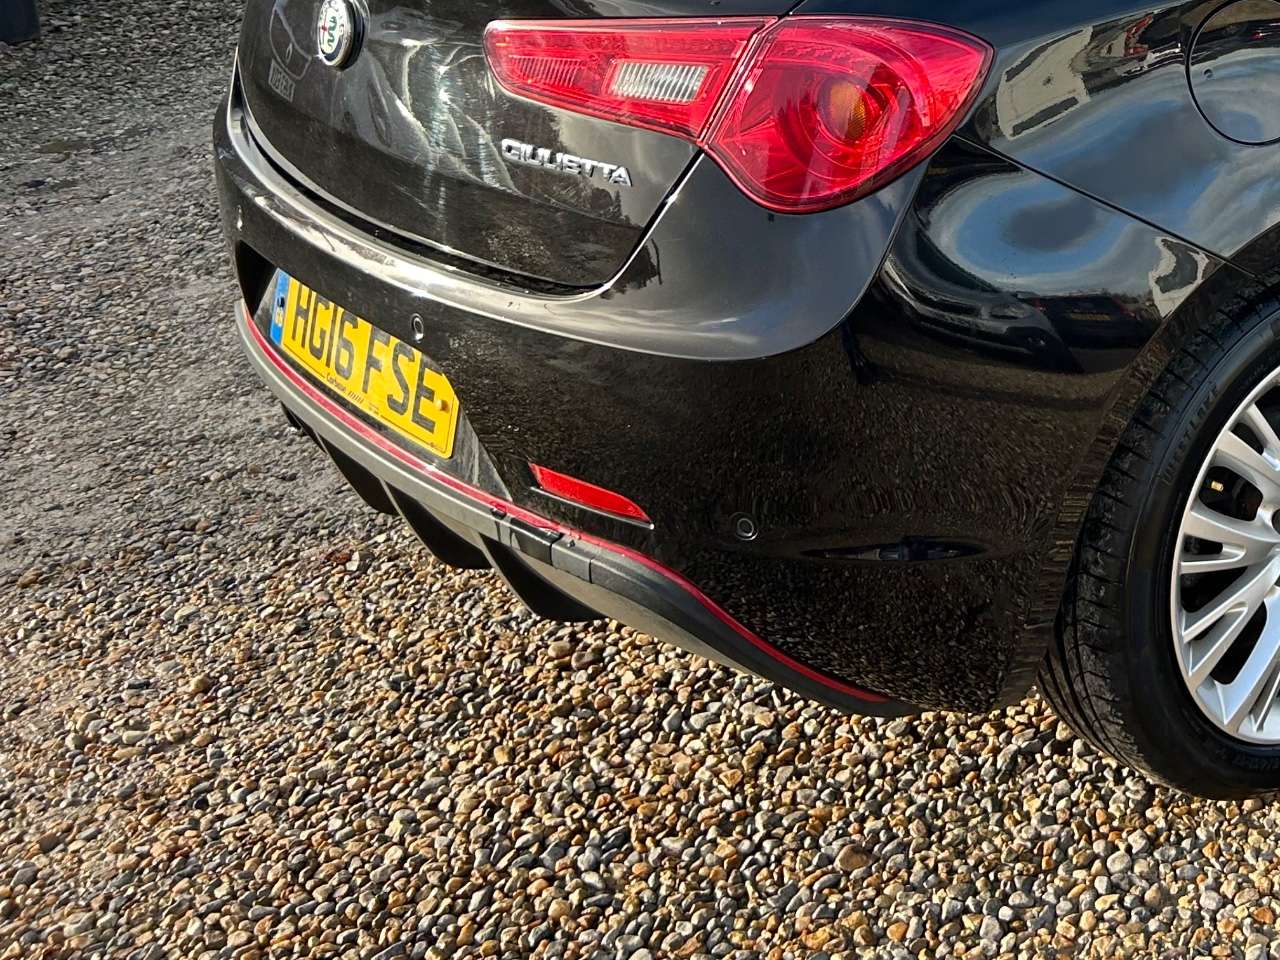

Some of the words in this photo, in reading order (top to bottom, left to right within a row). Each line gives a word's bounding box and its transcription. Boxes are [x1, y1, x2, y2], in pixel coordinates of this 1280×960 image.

[501, 138, 632, 187] GIULIETTA
[291, 284, 359, 381] HG16
[362, 324, 443, 435] FSE
